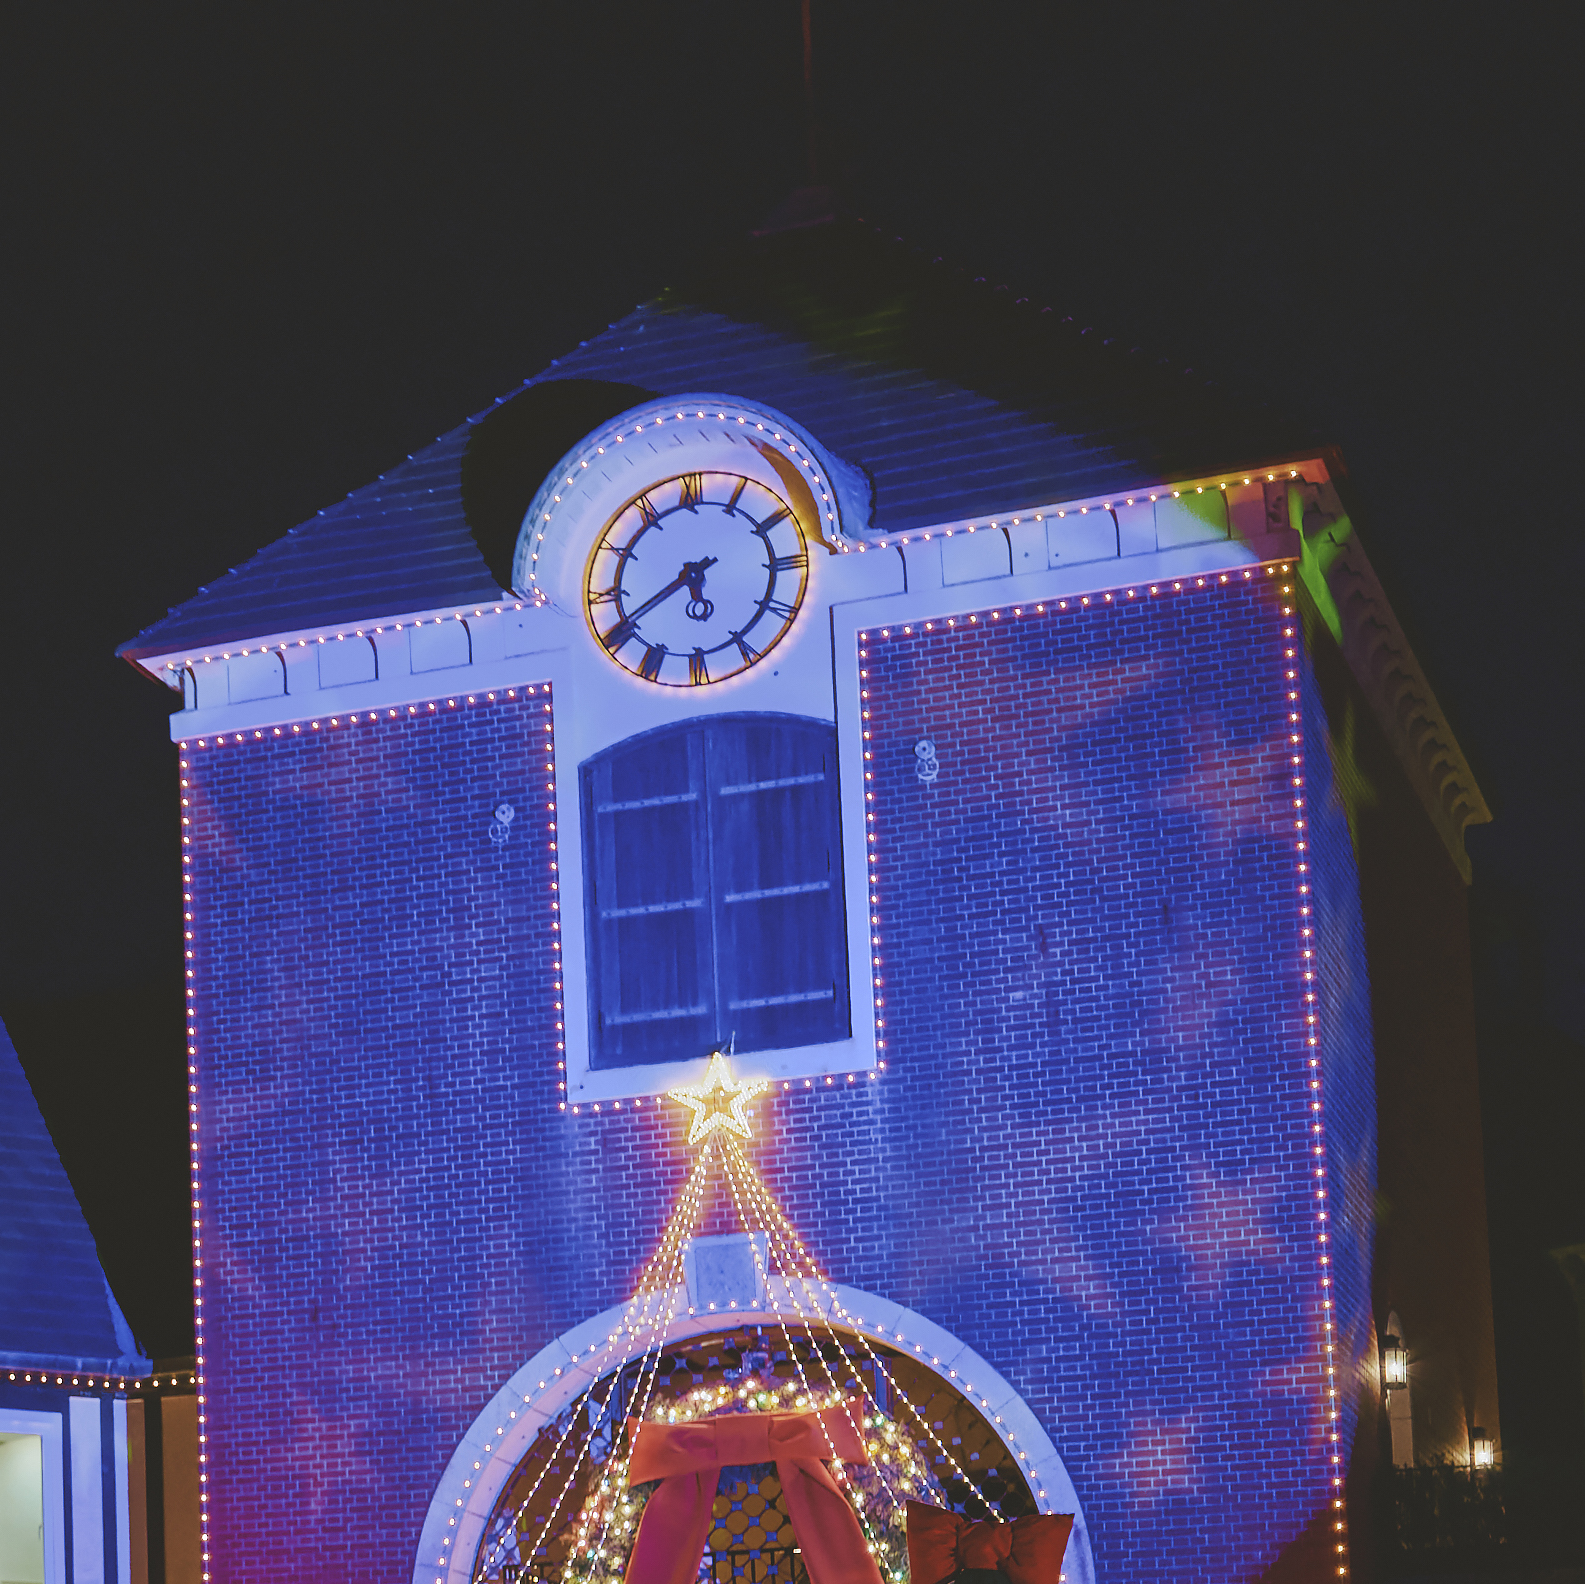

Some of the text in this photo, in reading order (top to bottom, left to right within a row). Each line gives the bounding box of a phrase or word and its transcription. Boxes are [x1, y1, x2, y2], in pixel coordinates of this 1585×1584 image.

[679, 472, 704, 510] XII
[724, 476, 748, 514] I
[753, 506, 792, 535] II
[766, 553, 809, 573] III
